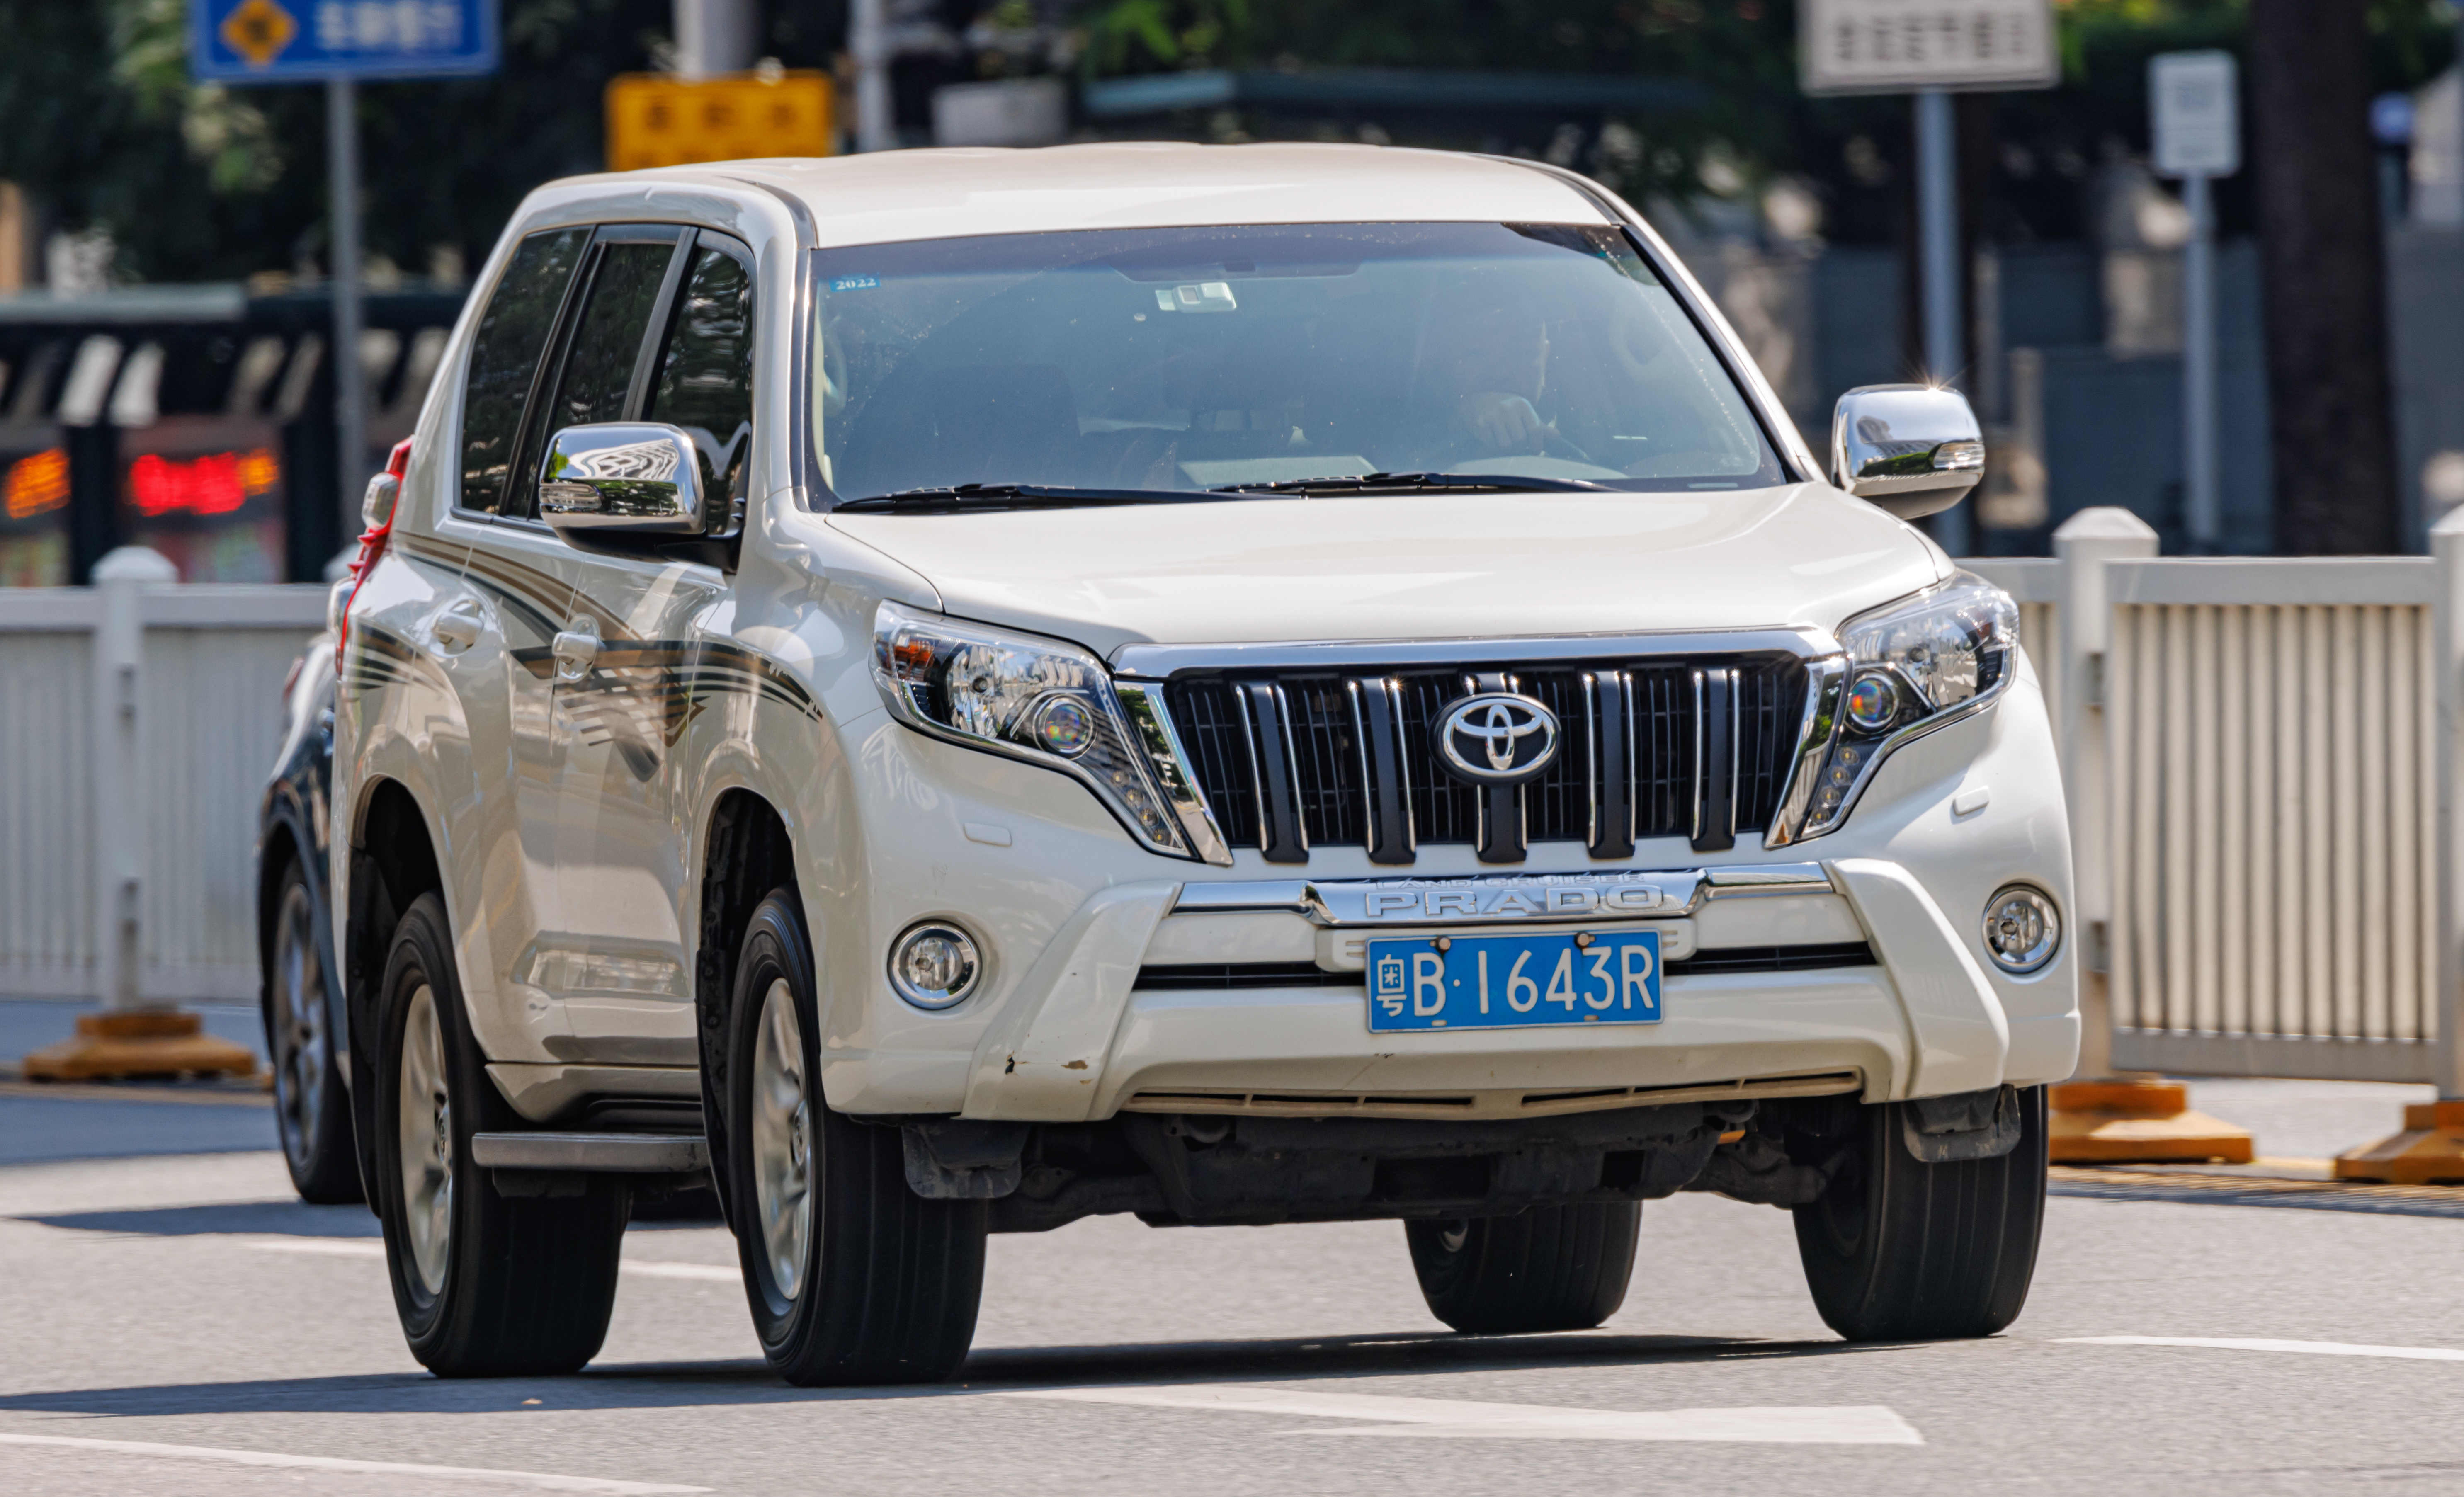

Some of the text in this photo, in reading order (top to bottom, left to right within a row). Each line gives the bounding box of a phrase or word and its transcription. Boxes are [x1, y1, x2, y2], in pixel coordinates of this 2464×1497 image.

[835, 277, 876, 290] 2022
[1376, 873, 1645, 890] LAND CRUISER
[1366, 885, 1664, 917] PRADO
[1376, 945, 1654, 1017] 粤B·1643R
